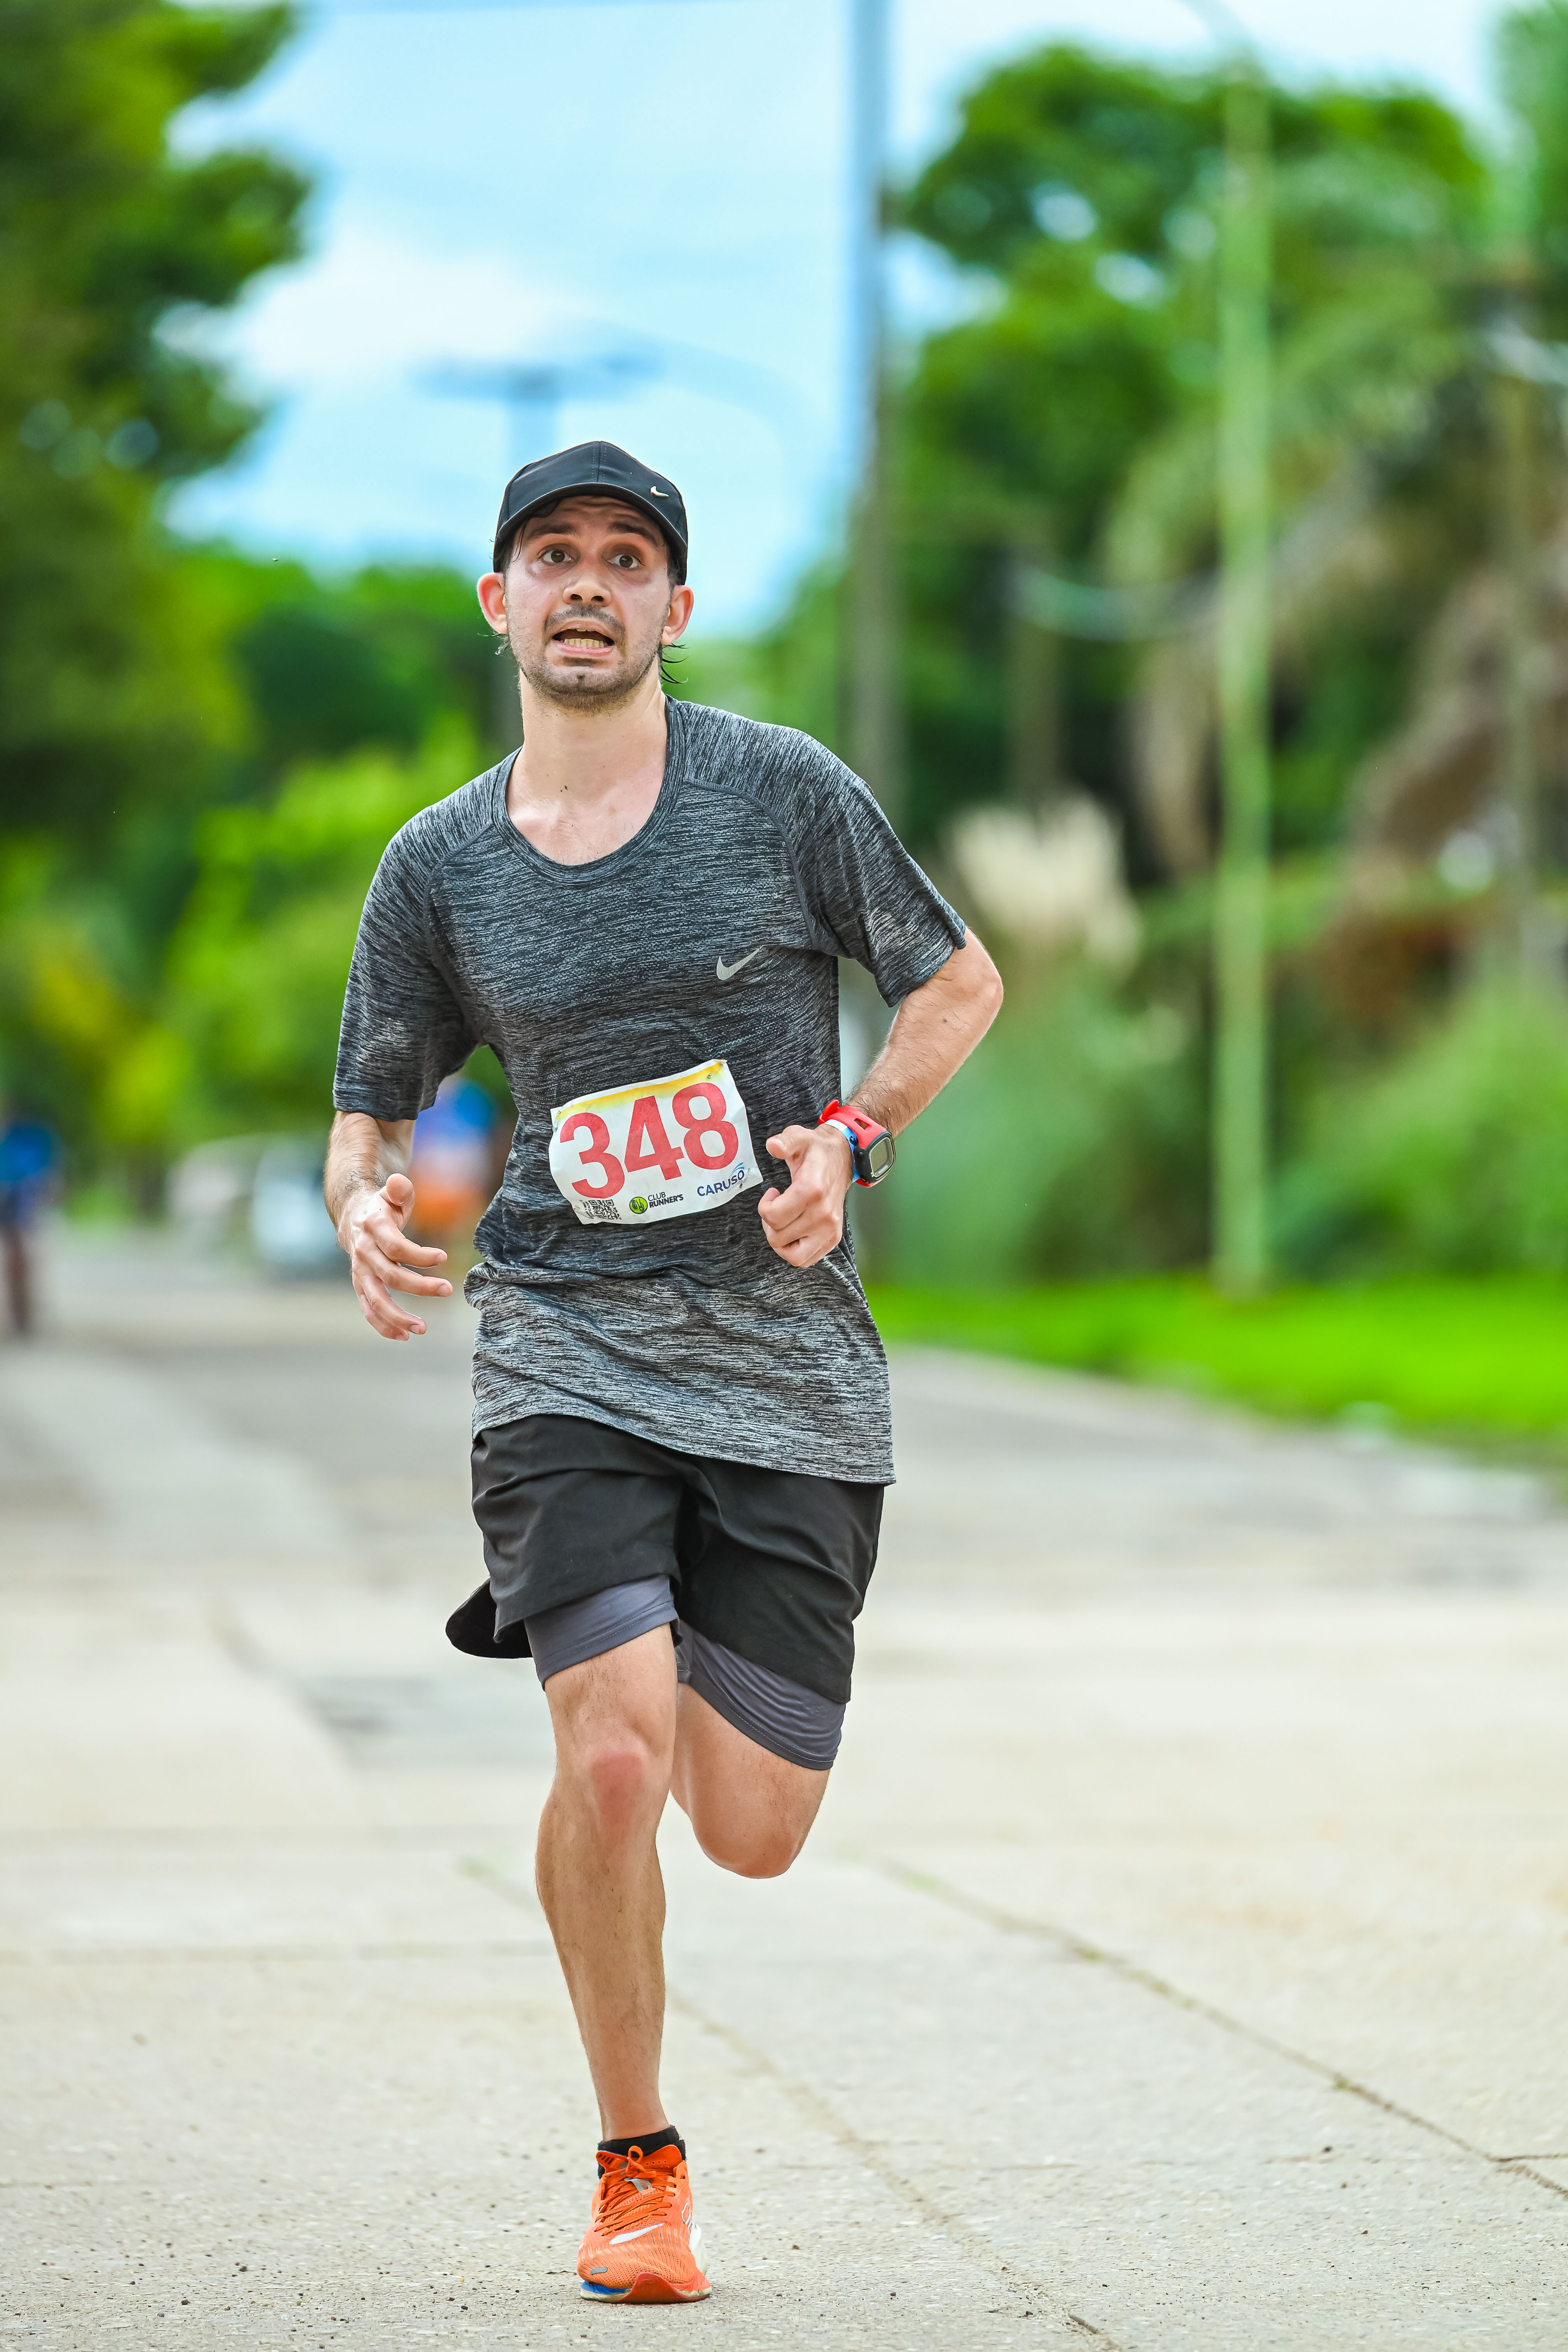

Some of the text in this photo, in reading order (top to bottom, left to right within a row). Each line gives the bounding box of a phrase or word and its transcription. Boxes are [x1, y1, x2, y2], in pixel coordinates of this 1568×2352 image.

[560, 1083, 738, 1198] 348
[697, 1170, 745, 1196] CARUSO
[648, 1192, 666, 1201] CLUB
[649, 1194, 684, 1208] RUNNER'S
